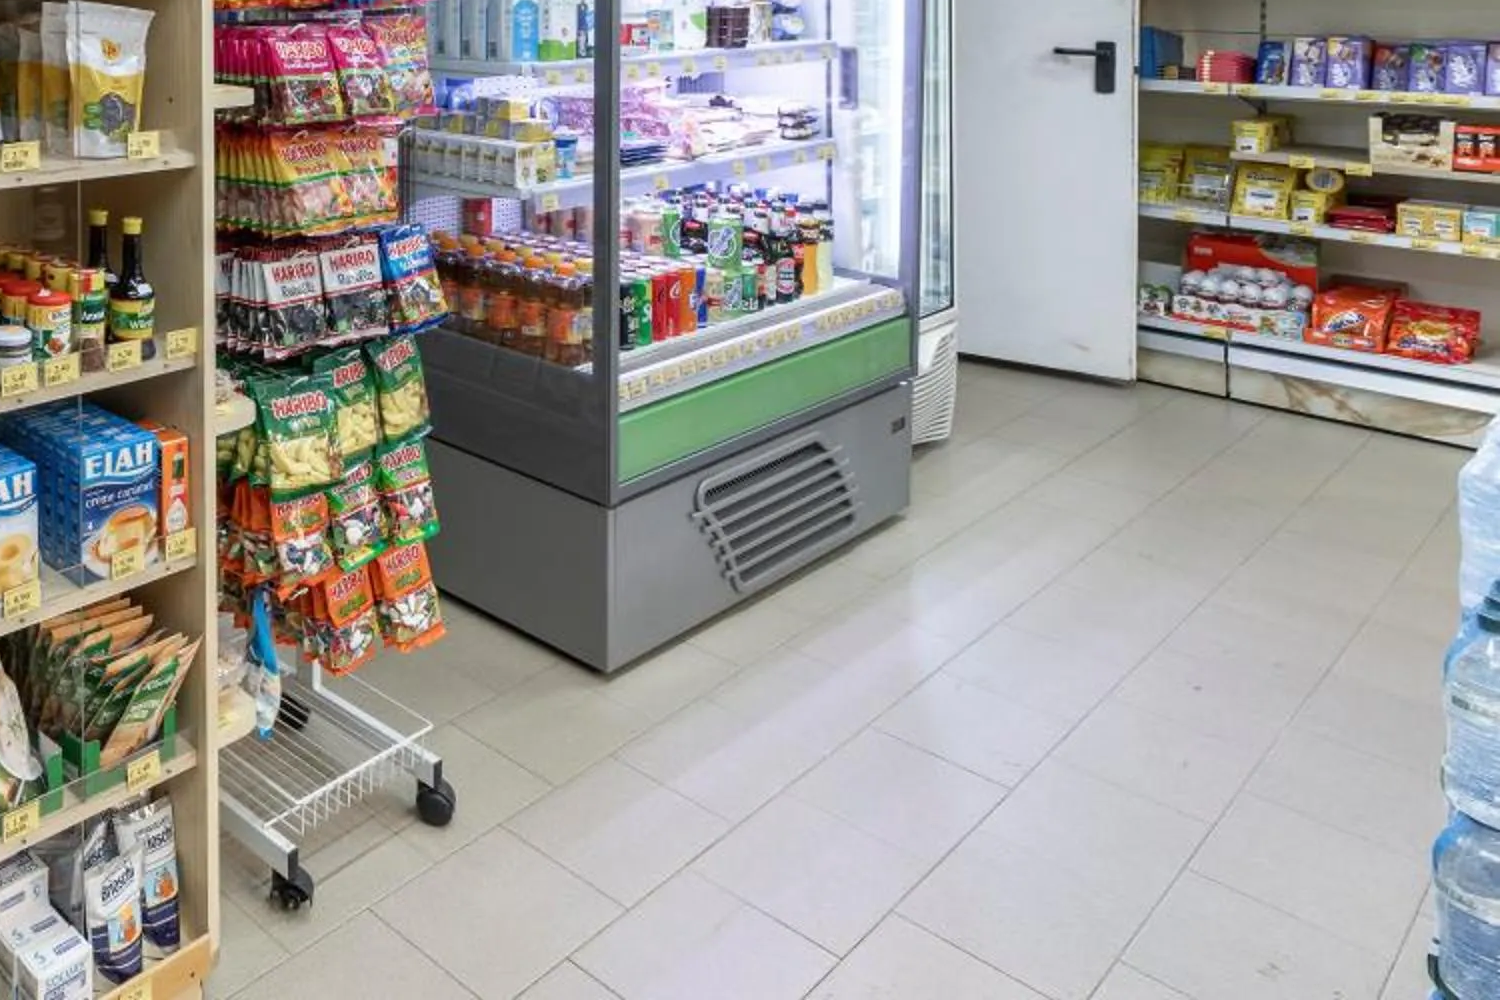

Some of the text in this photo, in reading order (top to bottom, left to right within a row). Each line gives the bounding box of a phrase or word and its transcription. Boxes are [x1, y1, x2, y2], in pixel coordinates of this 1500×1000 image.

[271, 262, 316, 283] HARIBO
[329, 250, 376, 272] HARIBO
[272, 391, 329, 420] HARIBO
[85, 440, 153, 480] ELAH
